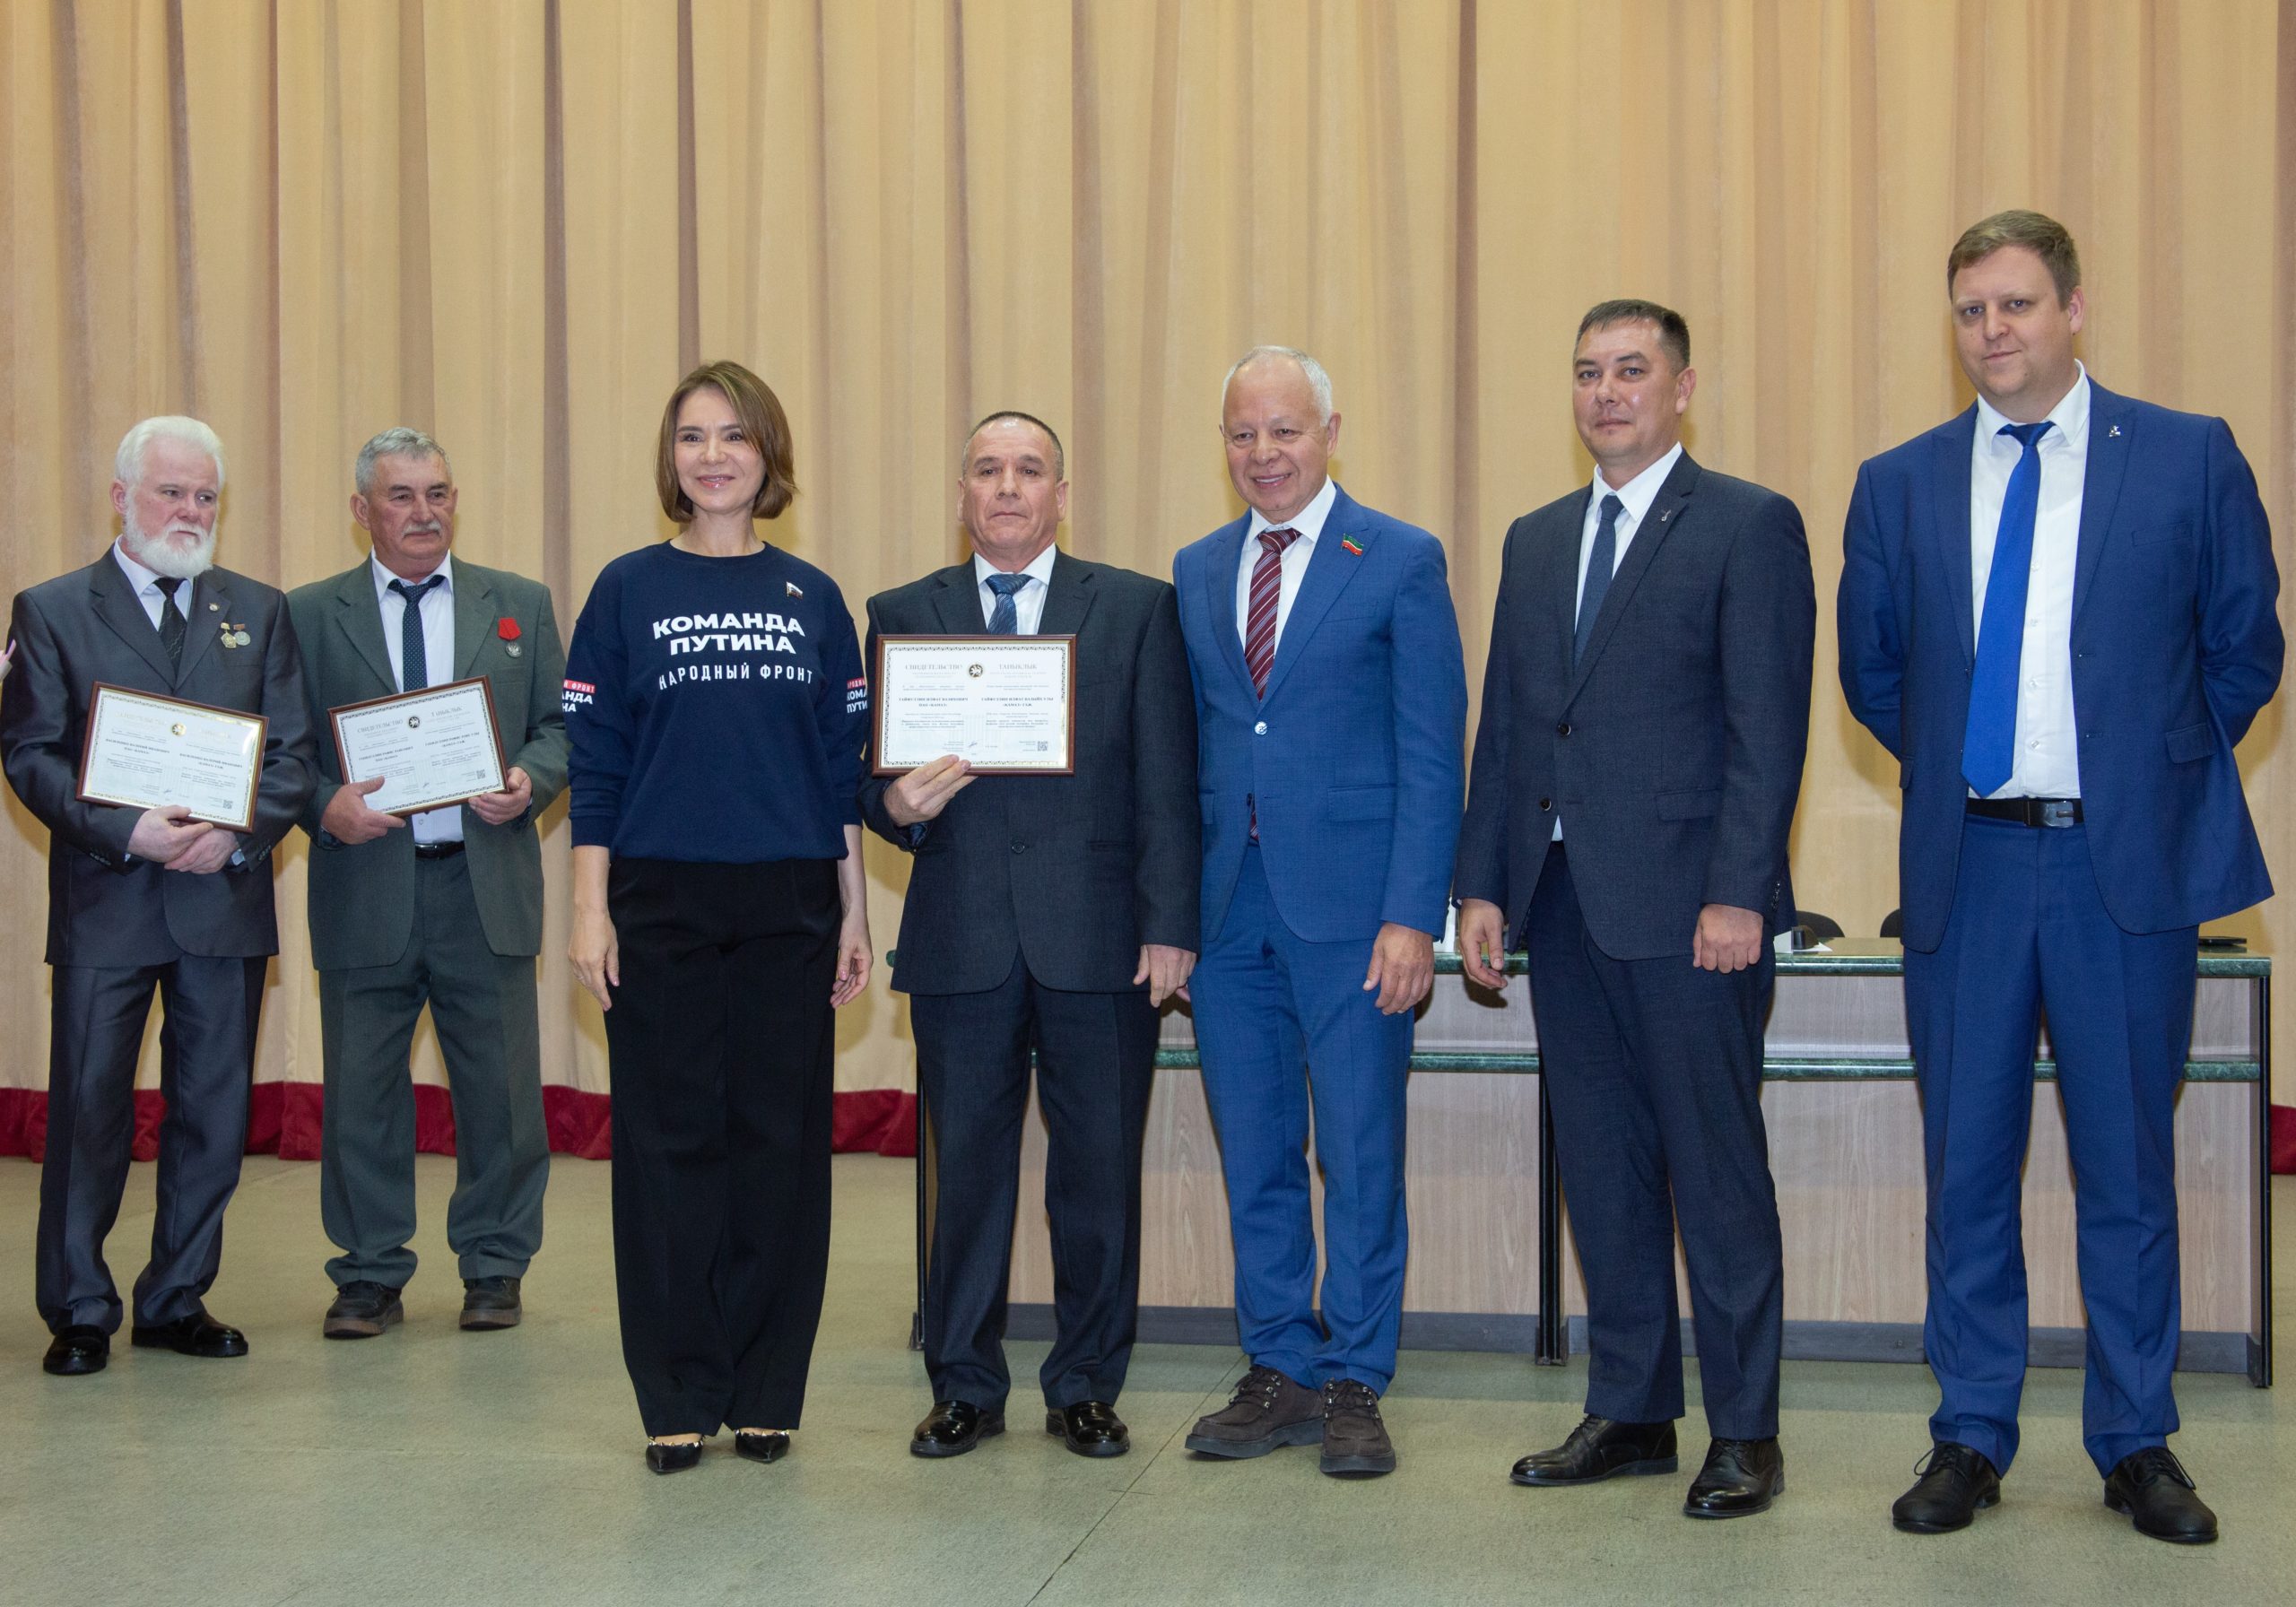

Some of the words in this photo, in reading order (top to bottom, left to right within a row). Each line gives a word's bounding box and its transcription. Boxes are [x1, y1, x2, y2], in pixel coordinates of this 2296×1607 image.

[653, 613, 805, 639] КОМАНДА
[670, 634, 796, 656] ПУТИНА
[659, 662, 750, 691] НАРОДНЫЙ
[760, 664, 813, 684] ФРОНТ
